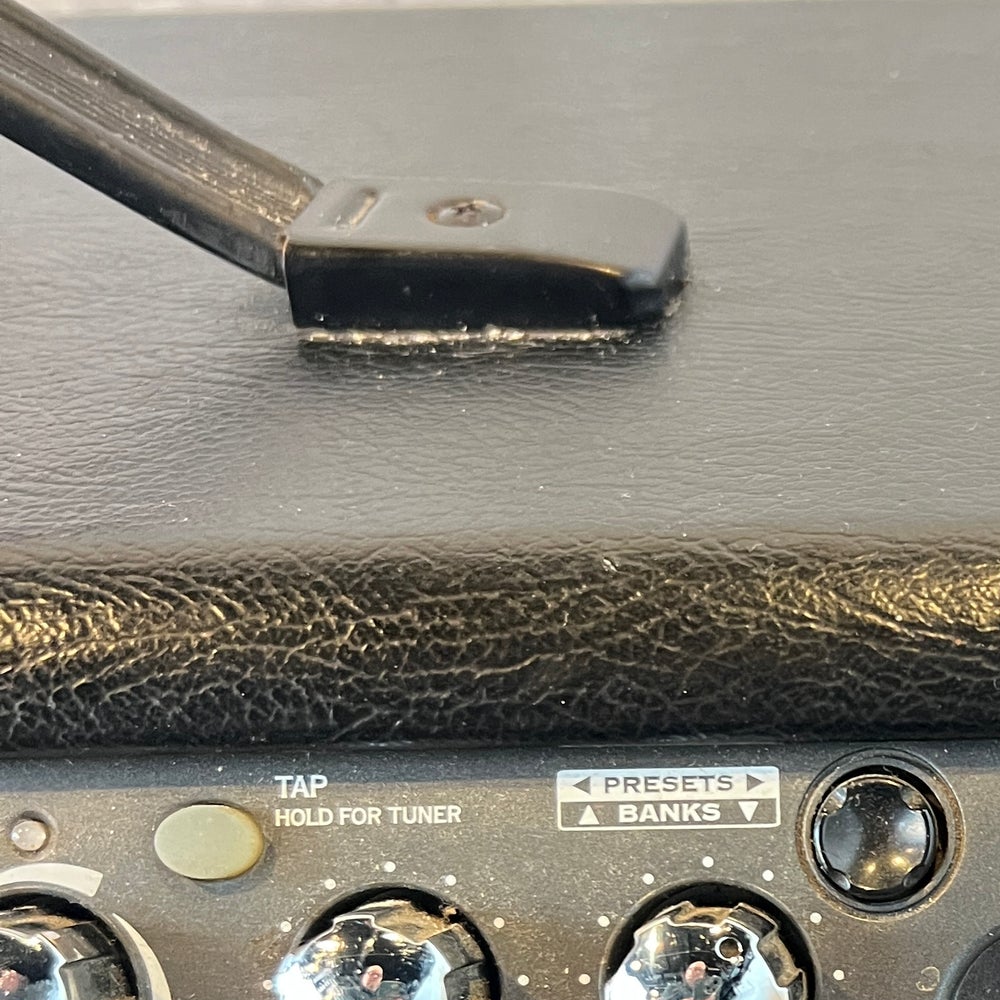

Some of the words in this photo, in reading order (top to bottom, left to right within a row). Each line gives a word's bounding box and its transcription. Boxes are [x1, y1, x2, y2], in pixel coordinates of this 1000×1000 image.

[275, 774, 328, 799] TAP
[604, 774, 734, 795] PRESETS
[275, 805, 336, 827] HOLD
[339, 805, 382, 826] FOR
[390, 804, 462, 825] TUNER
[618, 802, 721, 823] BANKS
